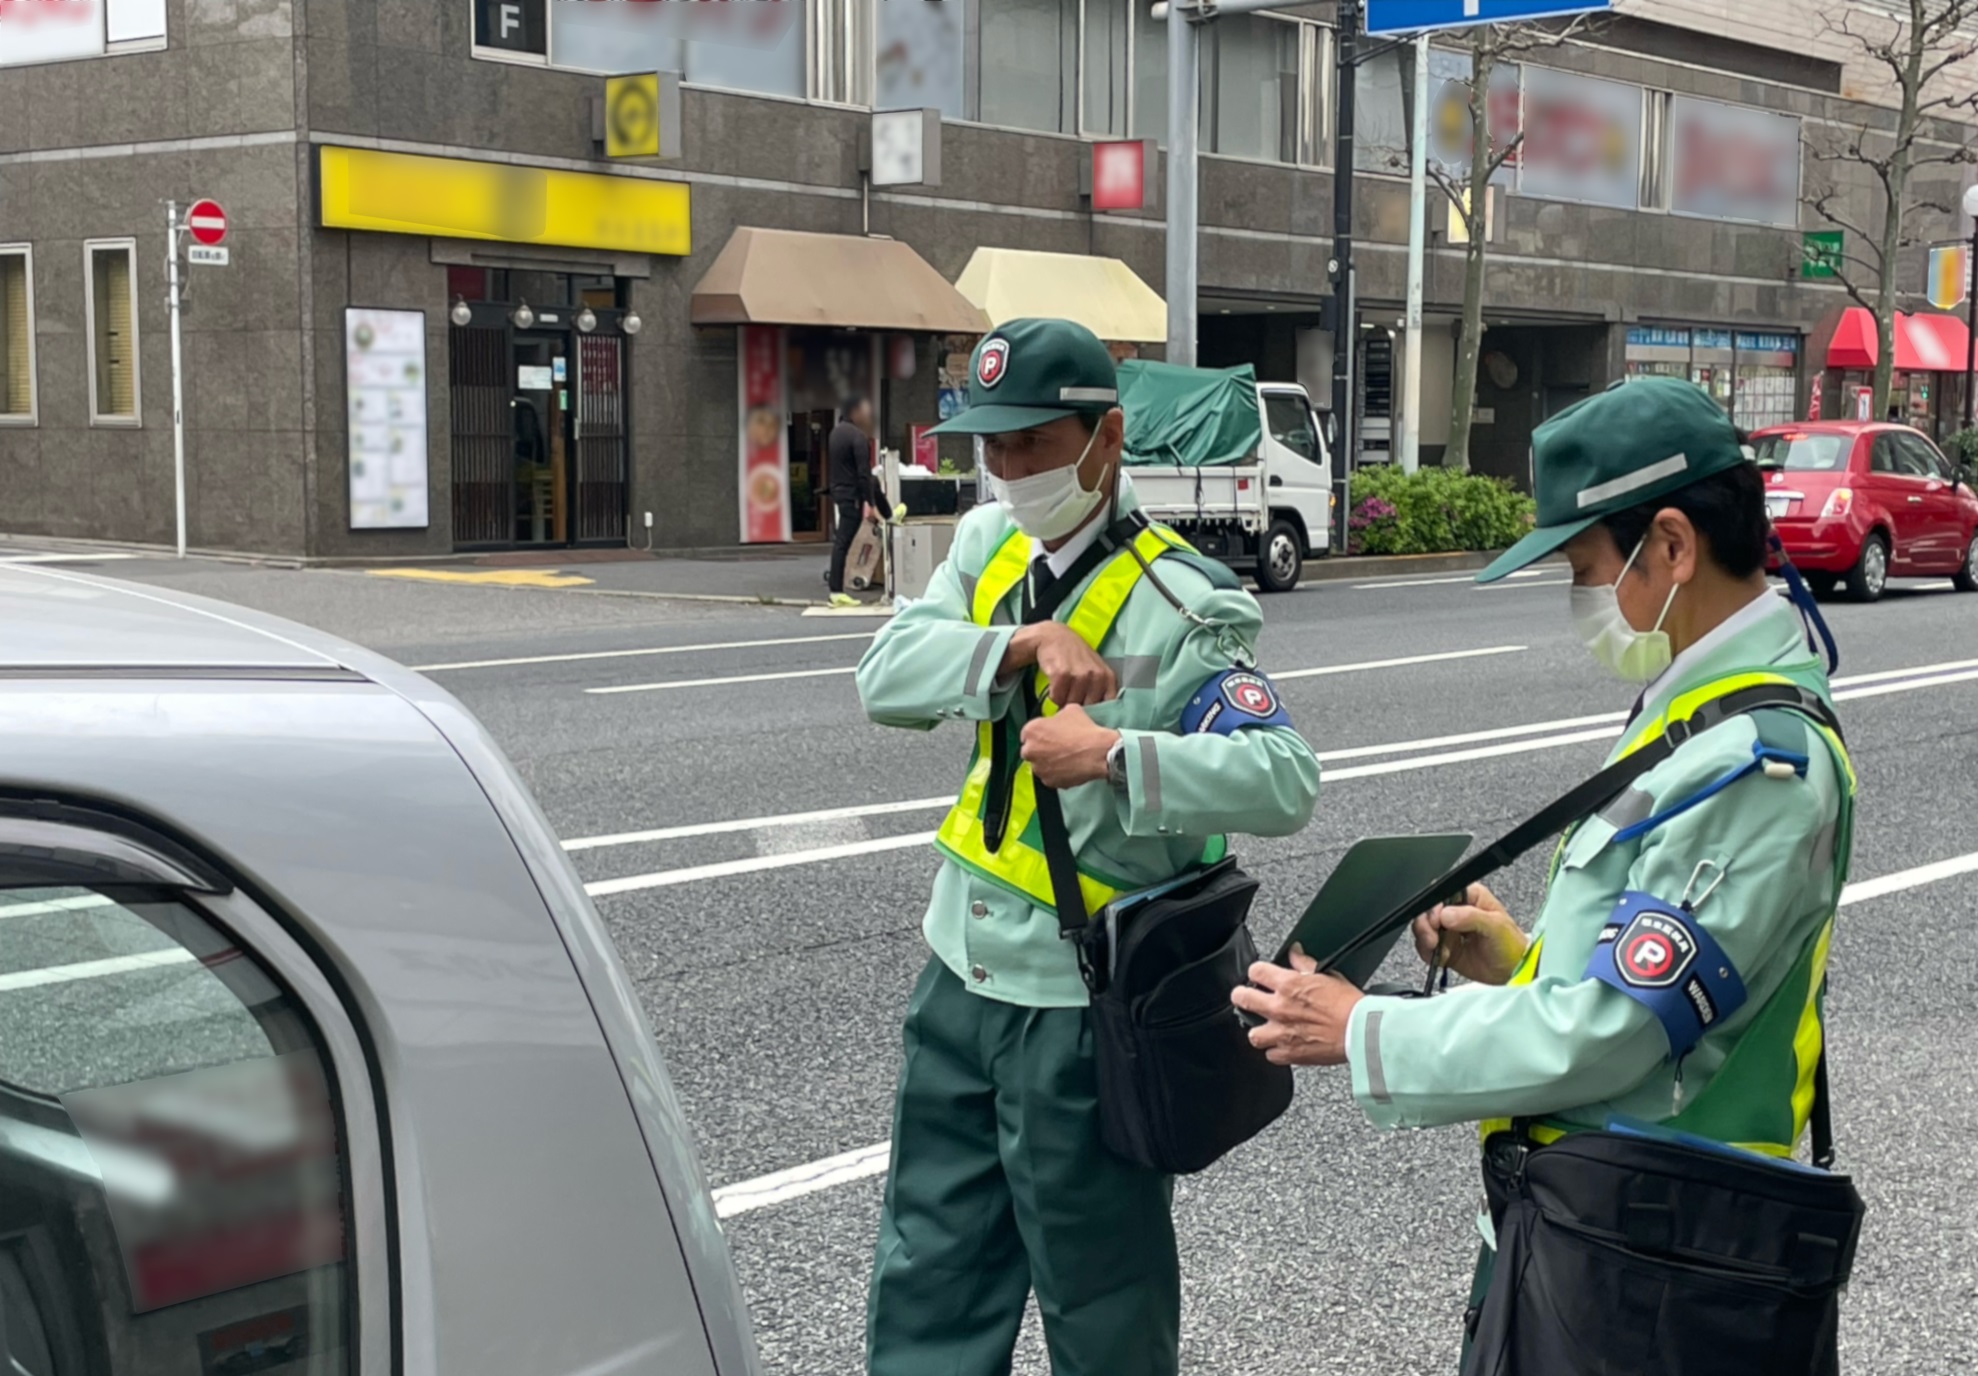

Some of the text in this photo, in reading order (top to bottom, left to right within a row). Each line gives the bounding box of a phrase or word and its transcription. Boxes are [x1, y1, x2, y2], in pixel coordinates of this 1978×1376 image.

[501, 3, 520, 39] F
[984, 356, 997, 375] P
[1243, 688, 1262, 706] P
[1634, 940, 1667, 964] P
[1688, 979, 1714, 1025] WARDEN
